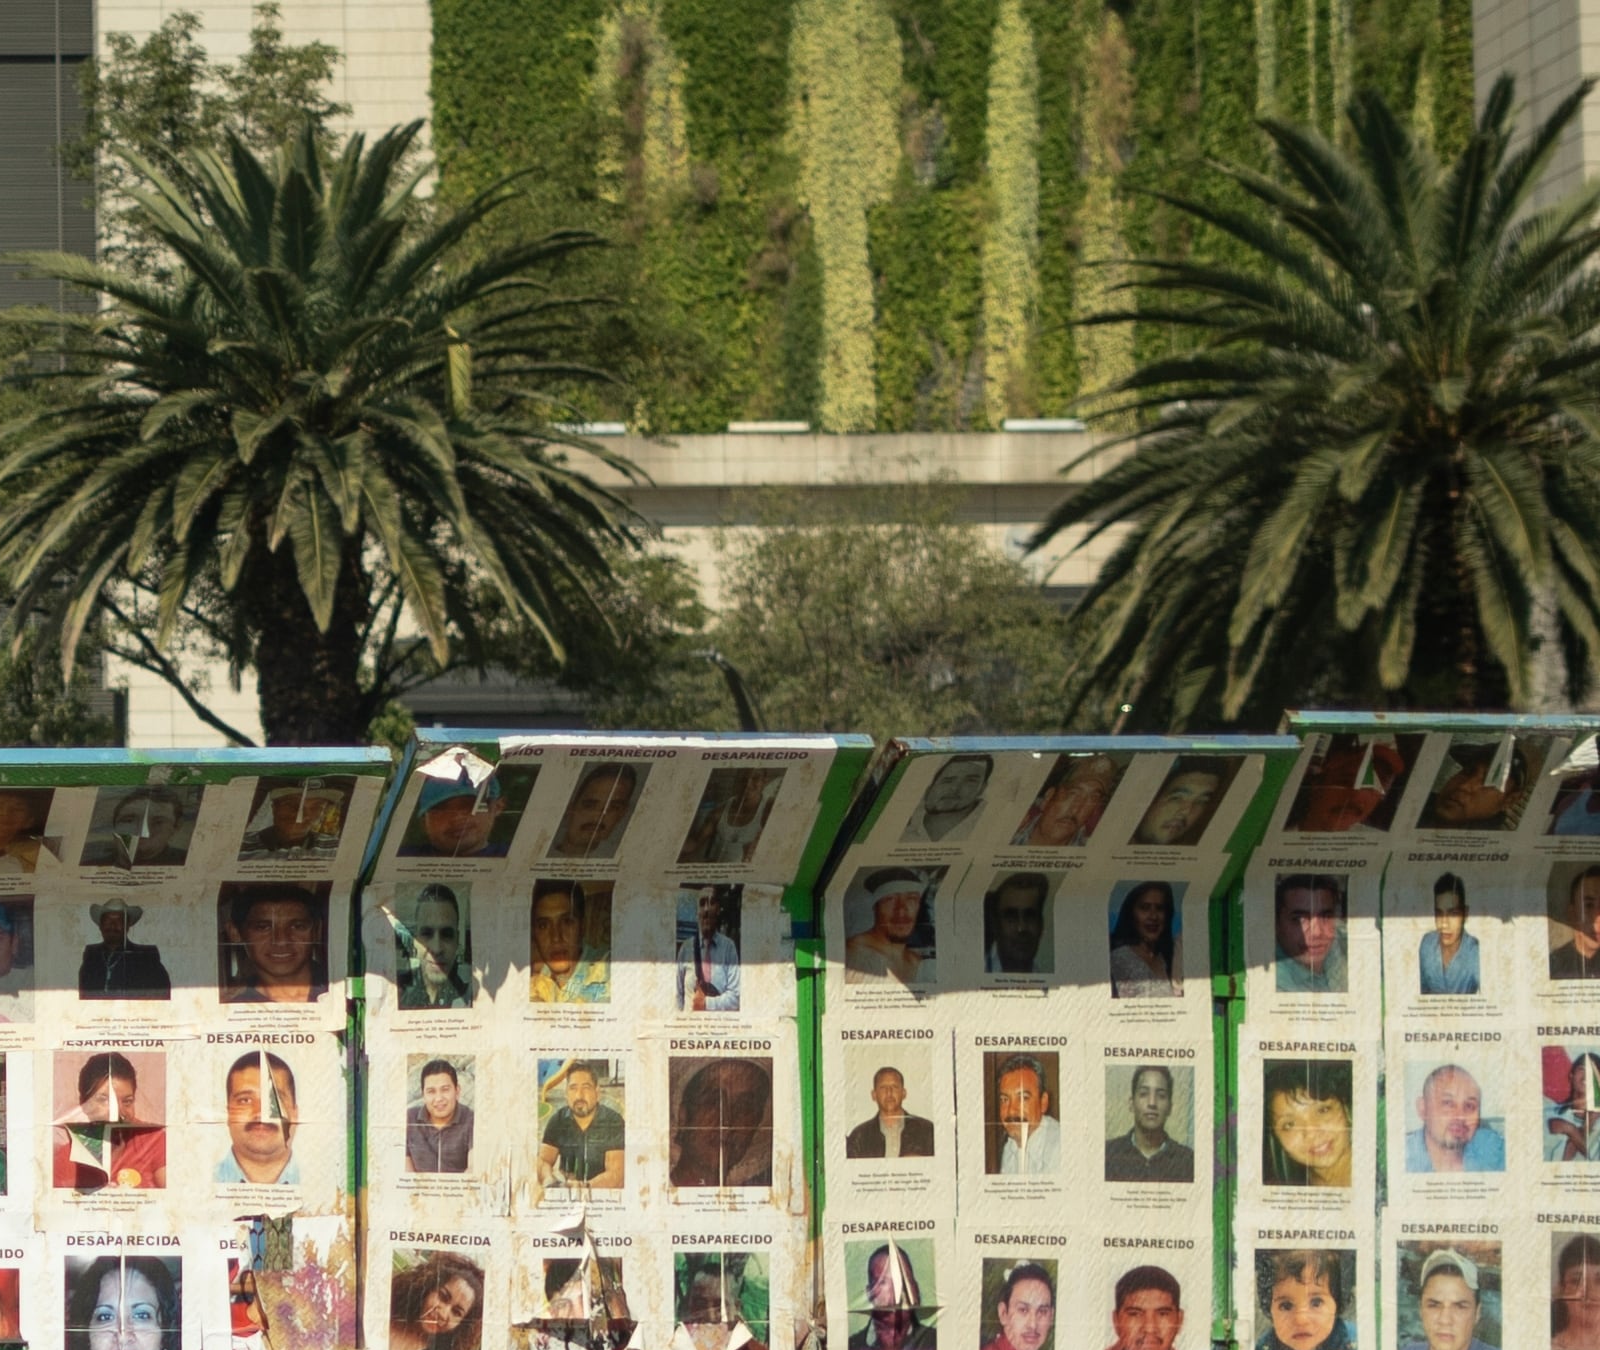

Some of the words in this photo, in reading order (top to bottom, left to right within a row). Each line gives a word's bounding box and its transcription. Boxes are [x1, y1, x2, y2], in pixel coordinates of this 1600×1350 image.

[569, 748, 678, 759] DESAPARECIDO
[701, 751, 809, 761] DESAPARECIDO
[1267, 858, 1368, 868] DESAPARECIDO
[1407, 852, 1510, 862] DESAPARECIDO
[206, 1033, 315, 1045] DESAPARECIDO
[840, 1028, 934, 1041] DESAPARECIDO
[1404, 1031, 1502, 1043] DESAPARECIDO
[974, 1035, 1068, 1047] DESAPARECIDO
[1258, 1040, 1357, 1053] DESAPARECIDA
[1103, 1046, 1196, 1059] DESAPARECIDO
[841, 1219, 936, 1235] DESAPARECIDO
[1401, 1223, 1499, 1235] DESAPARECIDO
[389, 1230, 492, 1247] DESAPARECIDA
[671, 1234, 773, 1245] DESAPARECIDO
[974, 1233, 1067, 1246] DESAPARECIDO
[1257, 1229, 1356, 1240] DESAPARECIDA
[66, 1235, 181, 1247] DESAPARECIDA
[532, 1235, 633, 1249] DESAPAECIDO
[1103, 1237, 1195, 1250] DESAPARECIDO
